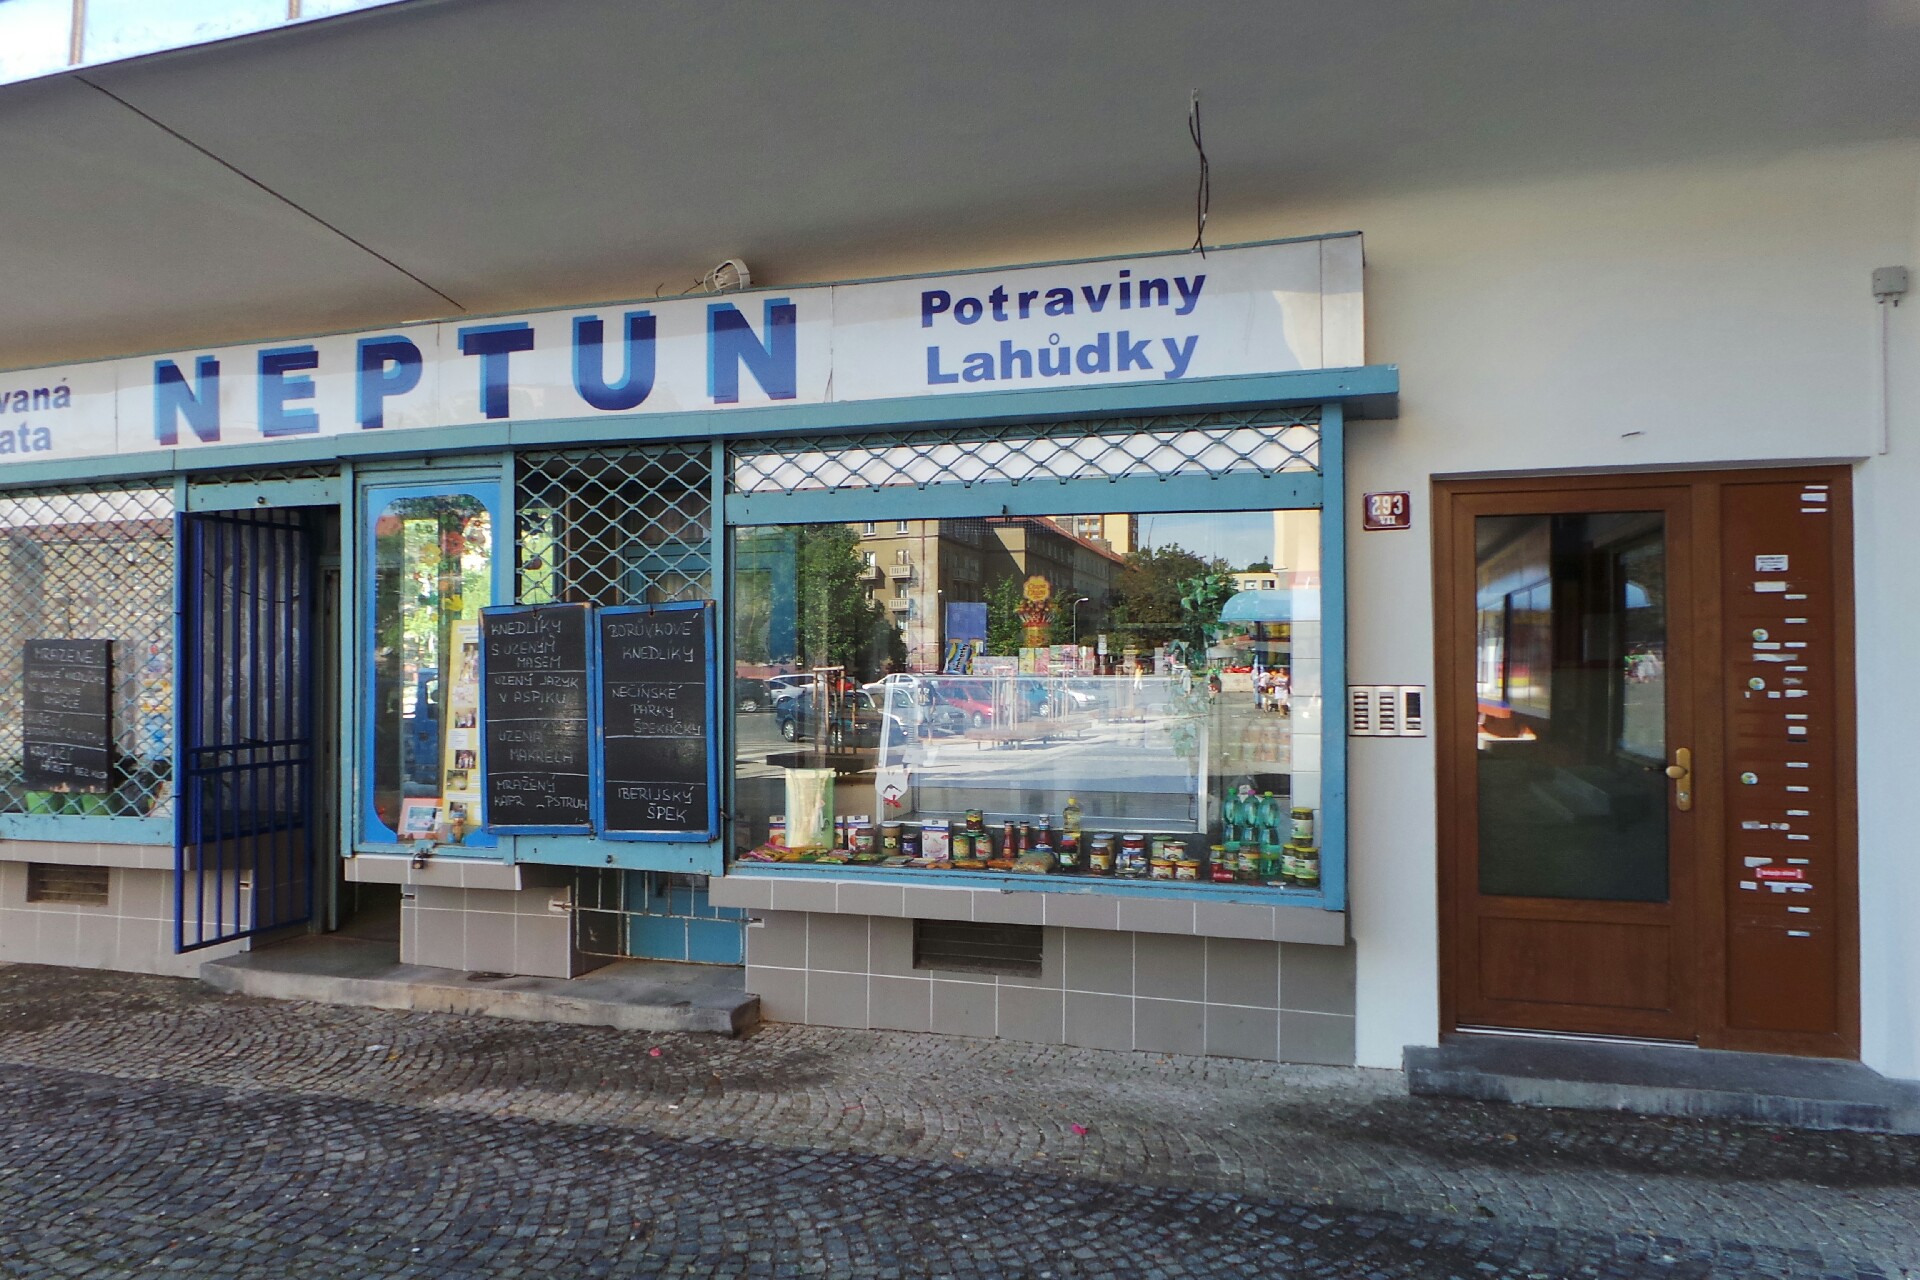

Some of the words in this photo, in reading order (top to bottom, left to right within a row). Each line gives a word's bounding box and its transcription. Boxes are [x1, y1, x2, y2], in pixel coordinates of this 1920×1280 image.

[921, 269, 1207, 328] Potraviny
[926, 329, 1199, 386] Lahůdky
[152, 297, 797, 446] NEPTUN
[1371, 495, 1404, 516] 293
[491, 615, 562, 635] KNEDLÍKY
[607, 612, 699, 638] BORŮVKOVÉ
[491, 643, 499, 656] S
[622, 639, 694, 662] KNEDLÍKY
[517, 655, 561, 669] MASEM
[495, 673, 533, 686] UZENÝ
[539, 675, 579, 689] JAZYK
[499, 692, 507, 703] V
[513, 690, 566, 704] ASPIKU
[630, 700, 674, 719] PÁRKY
[509, 748, 574, 764] MAKRELA
[494, 795, 526, 807] KAPR
[544, 795, 588, 811] PSTRUH
[617, 785, 695, 804] IBERIJSKÝ
[646, 802, 688, 824] ŠPEK
